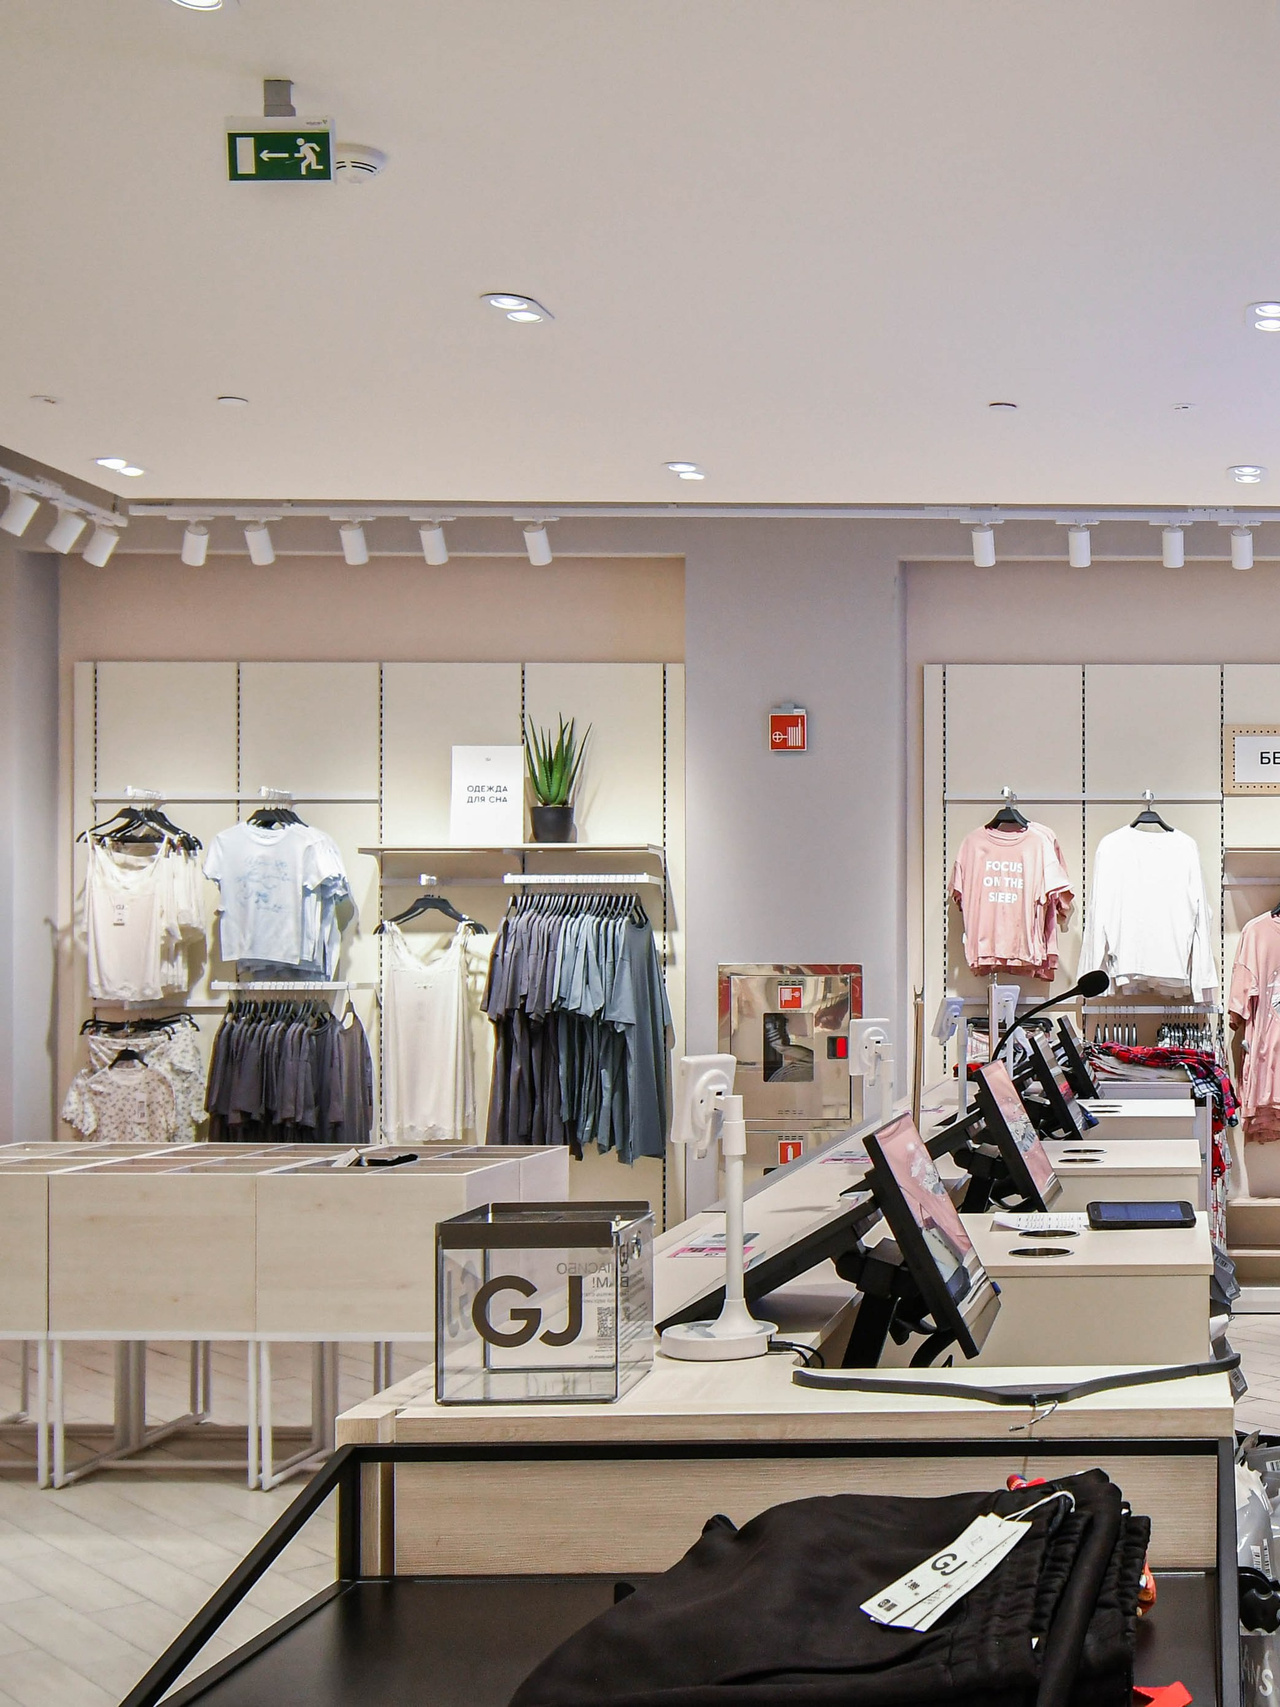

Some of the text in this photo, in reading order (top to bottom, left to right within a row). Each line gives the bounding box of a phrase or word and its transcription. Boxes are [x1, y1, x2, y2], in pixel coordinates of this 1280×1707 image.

[466, 785, 508, 793] ОДЕЖДА
[466, 796, 486, 804] ДЛЯ
[985, 860, 1023, 873] FOCUS
[983, 876, 1024, 889] ON THE
[472, 1275, 583, 1348] GJ
[931, 1553, 968, 1576] GJ
